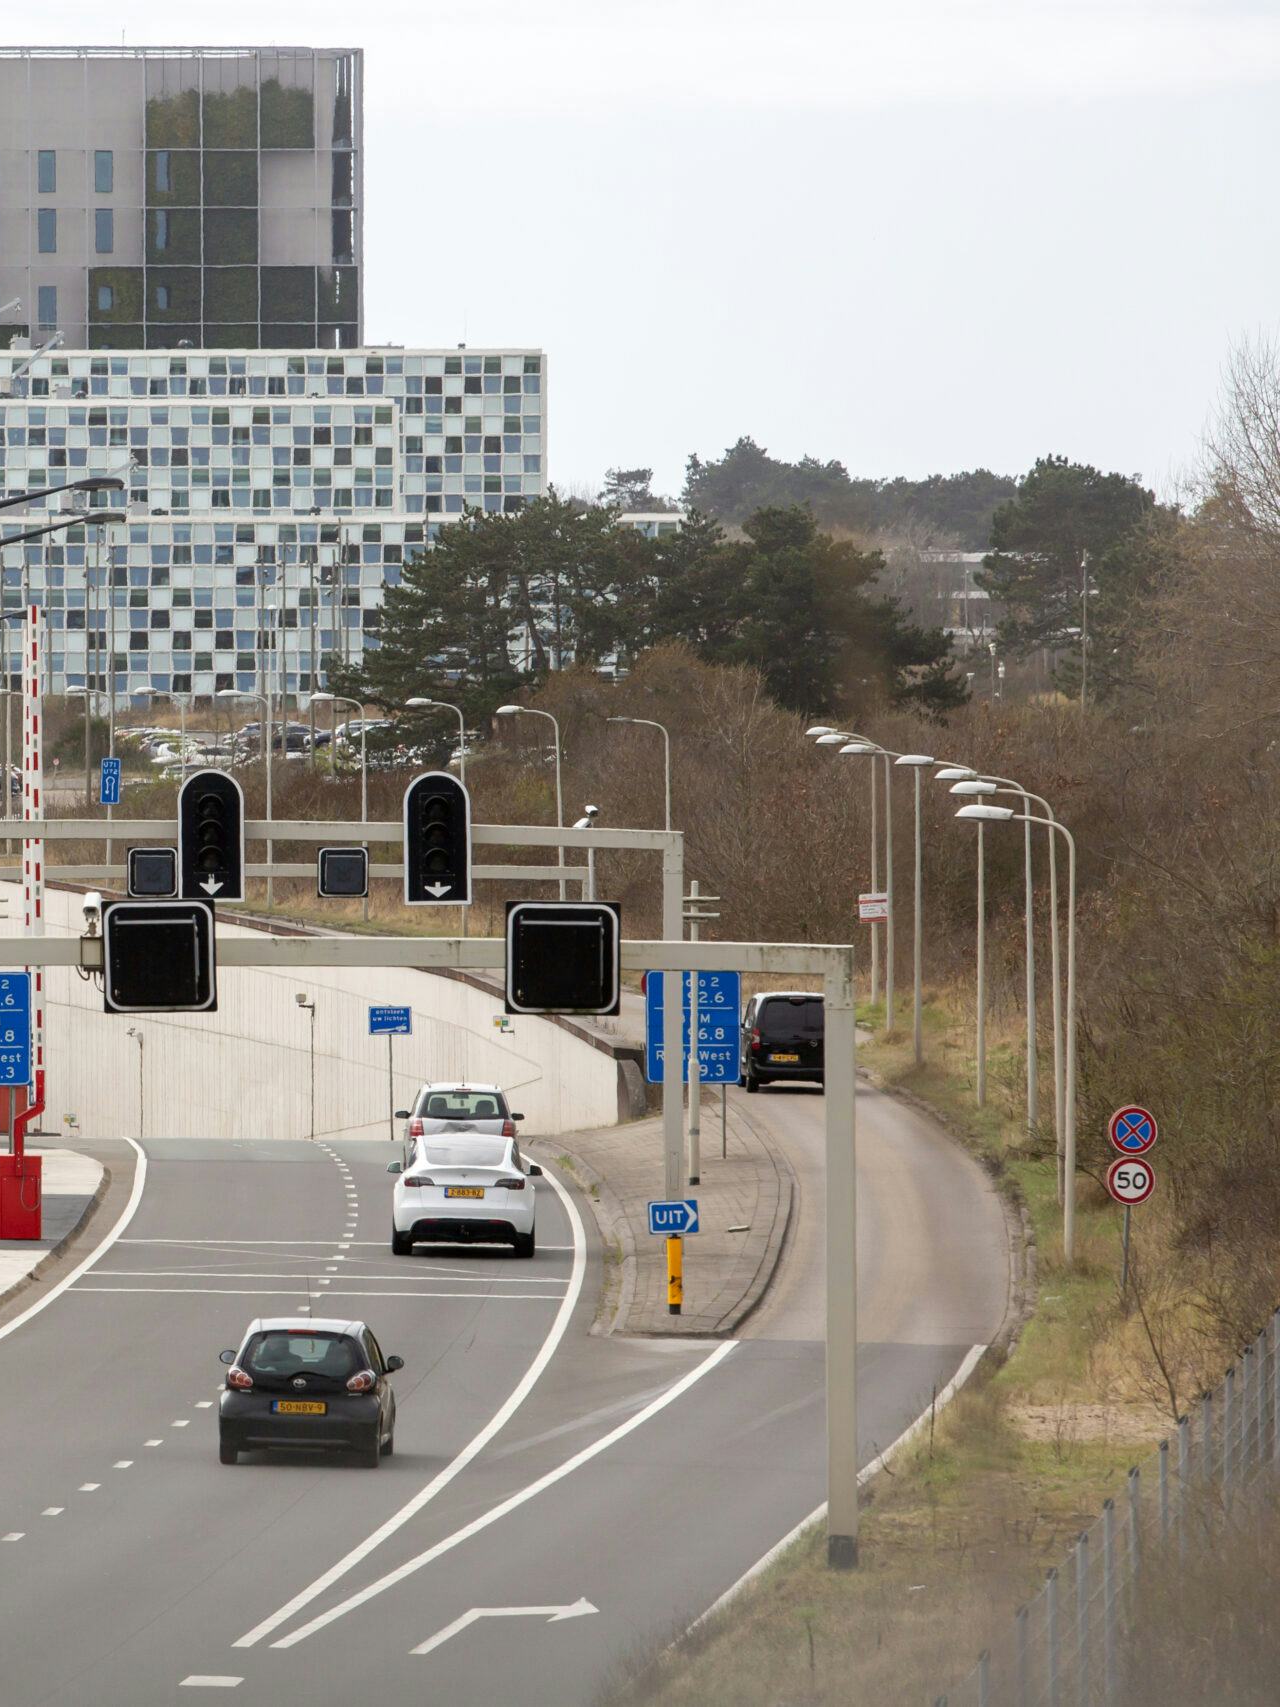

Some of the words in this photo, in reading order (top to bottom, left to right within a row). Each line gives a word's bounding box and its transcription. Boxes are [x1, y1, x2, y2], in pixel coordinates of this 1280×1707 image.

[1, 979, 10, 989] 2
[711, 976, 719, 987] 2
[699, 1050, 731, 1060] West
[1117, 1171, 1147, 1190] 50
[655, 1210, 684, 1224] UIT
